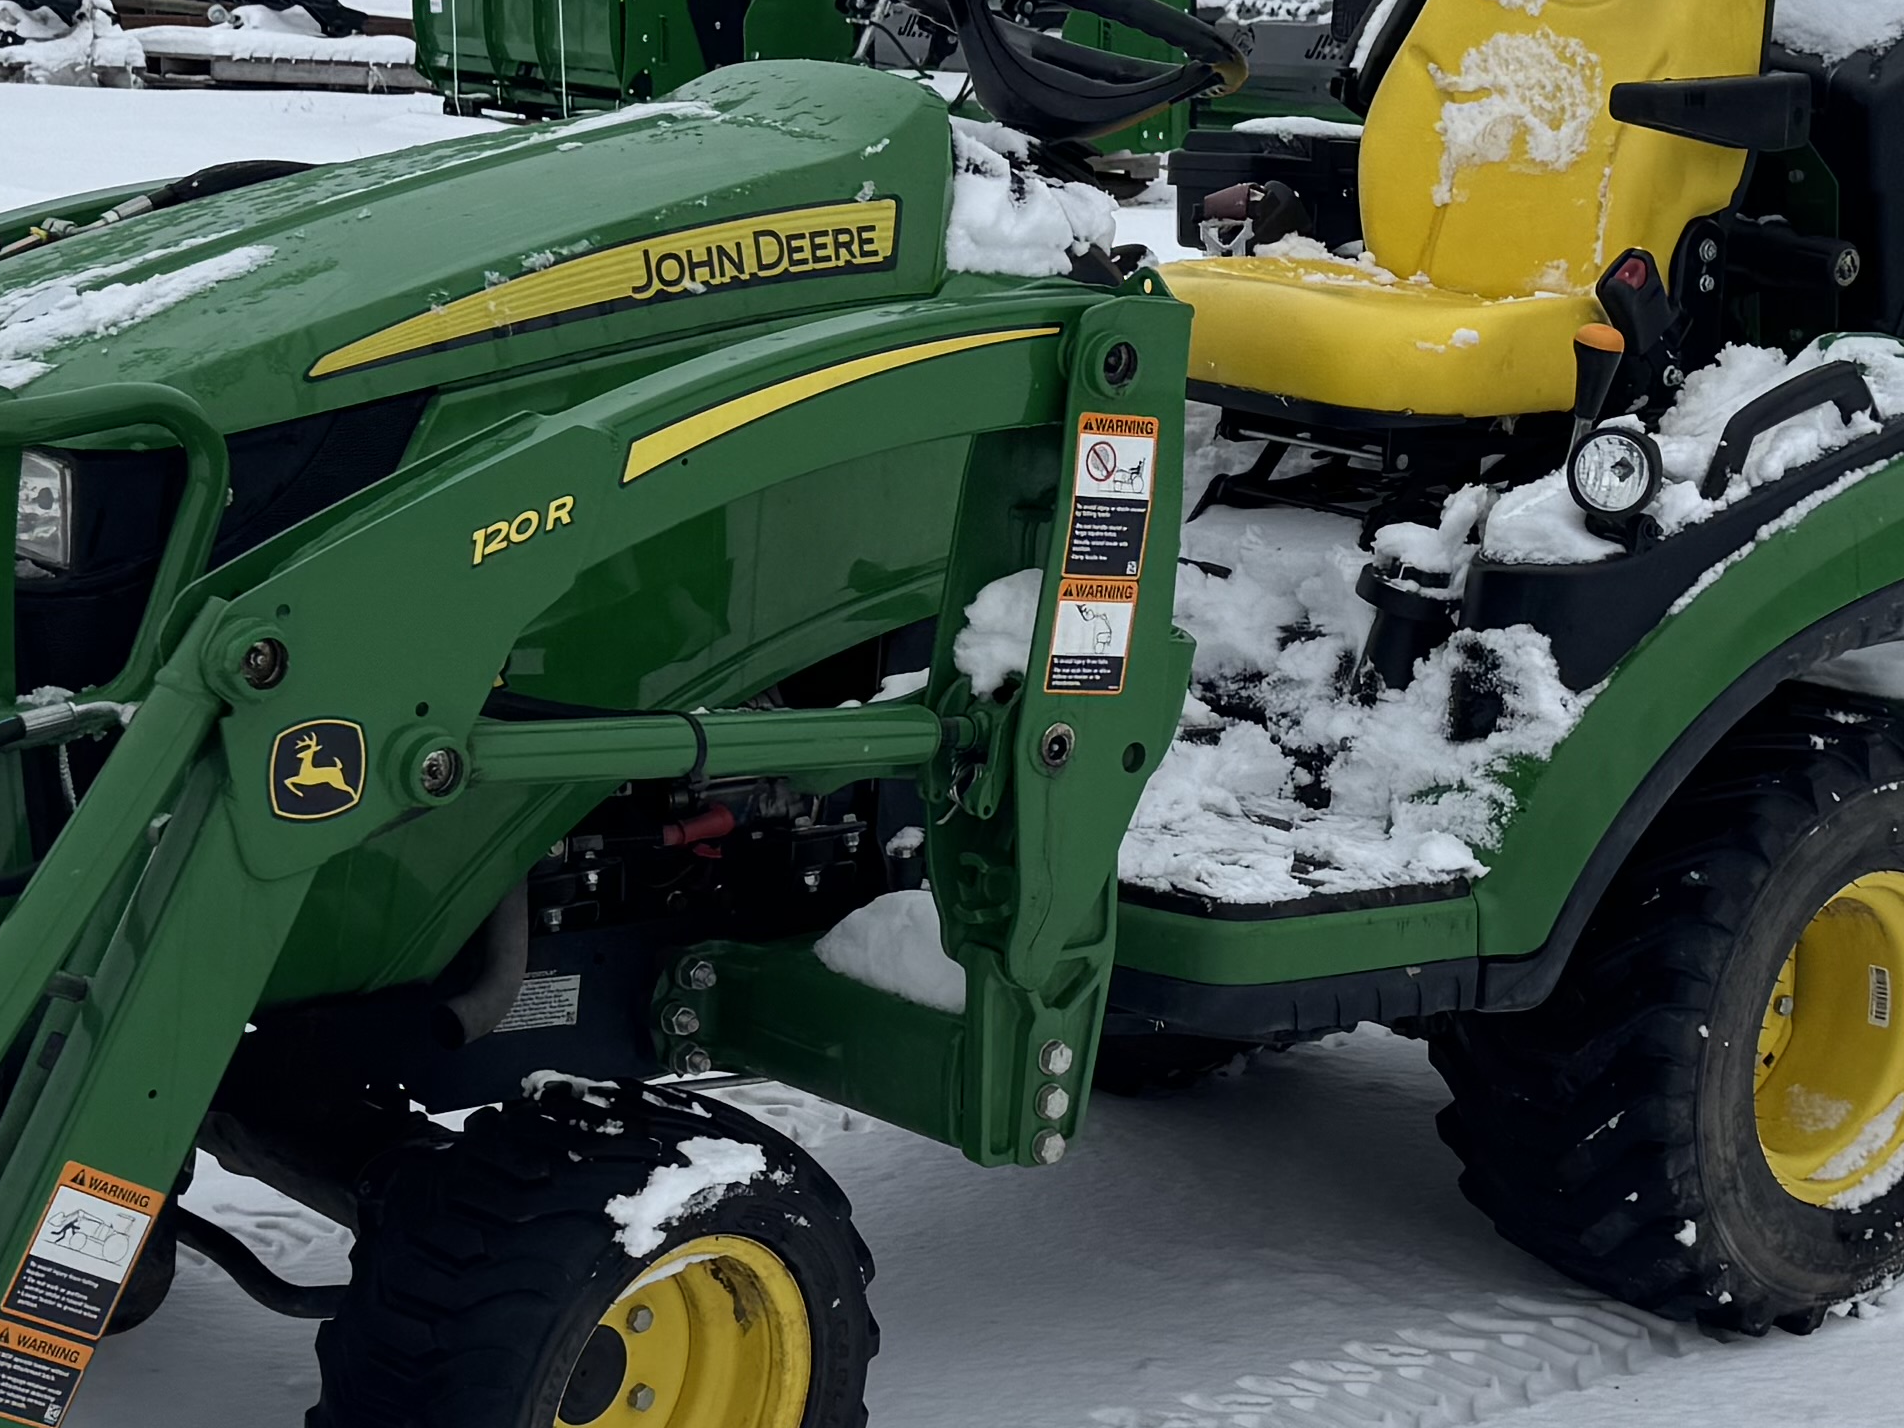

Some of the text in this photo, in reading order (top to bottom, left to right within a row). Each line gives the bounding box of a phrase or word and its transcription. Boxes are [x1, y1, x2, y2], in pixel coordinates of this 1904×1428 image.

[631, 224, 879, 294] JOHN DEERE
[1094, 416, 1155, 436] WARNING
[472, 495, 574, 565] 120 R
[1074, 582, 1134, 600] WARNING
[87, 1175, 150, 1209] WARNING
[16, 1333, 81, 1364] WARNING
